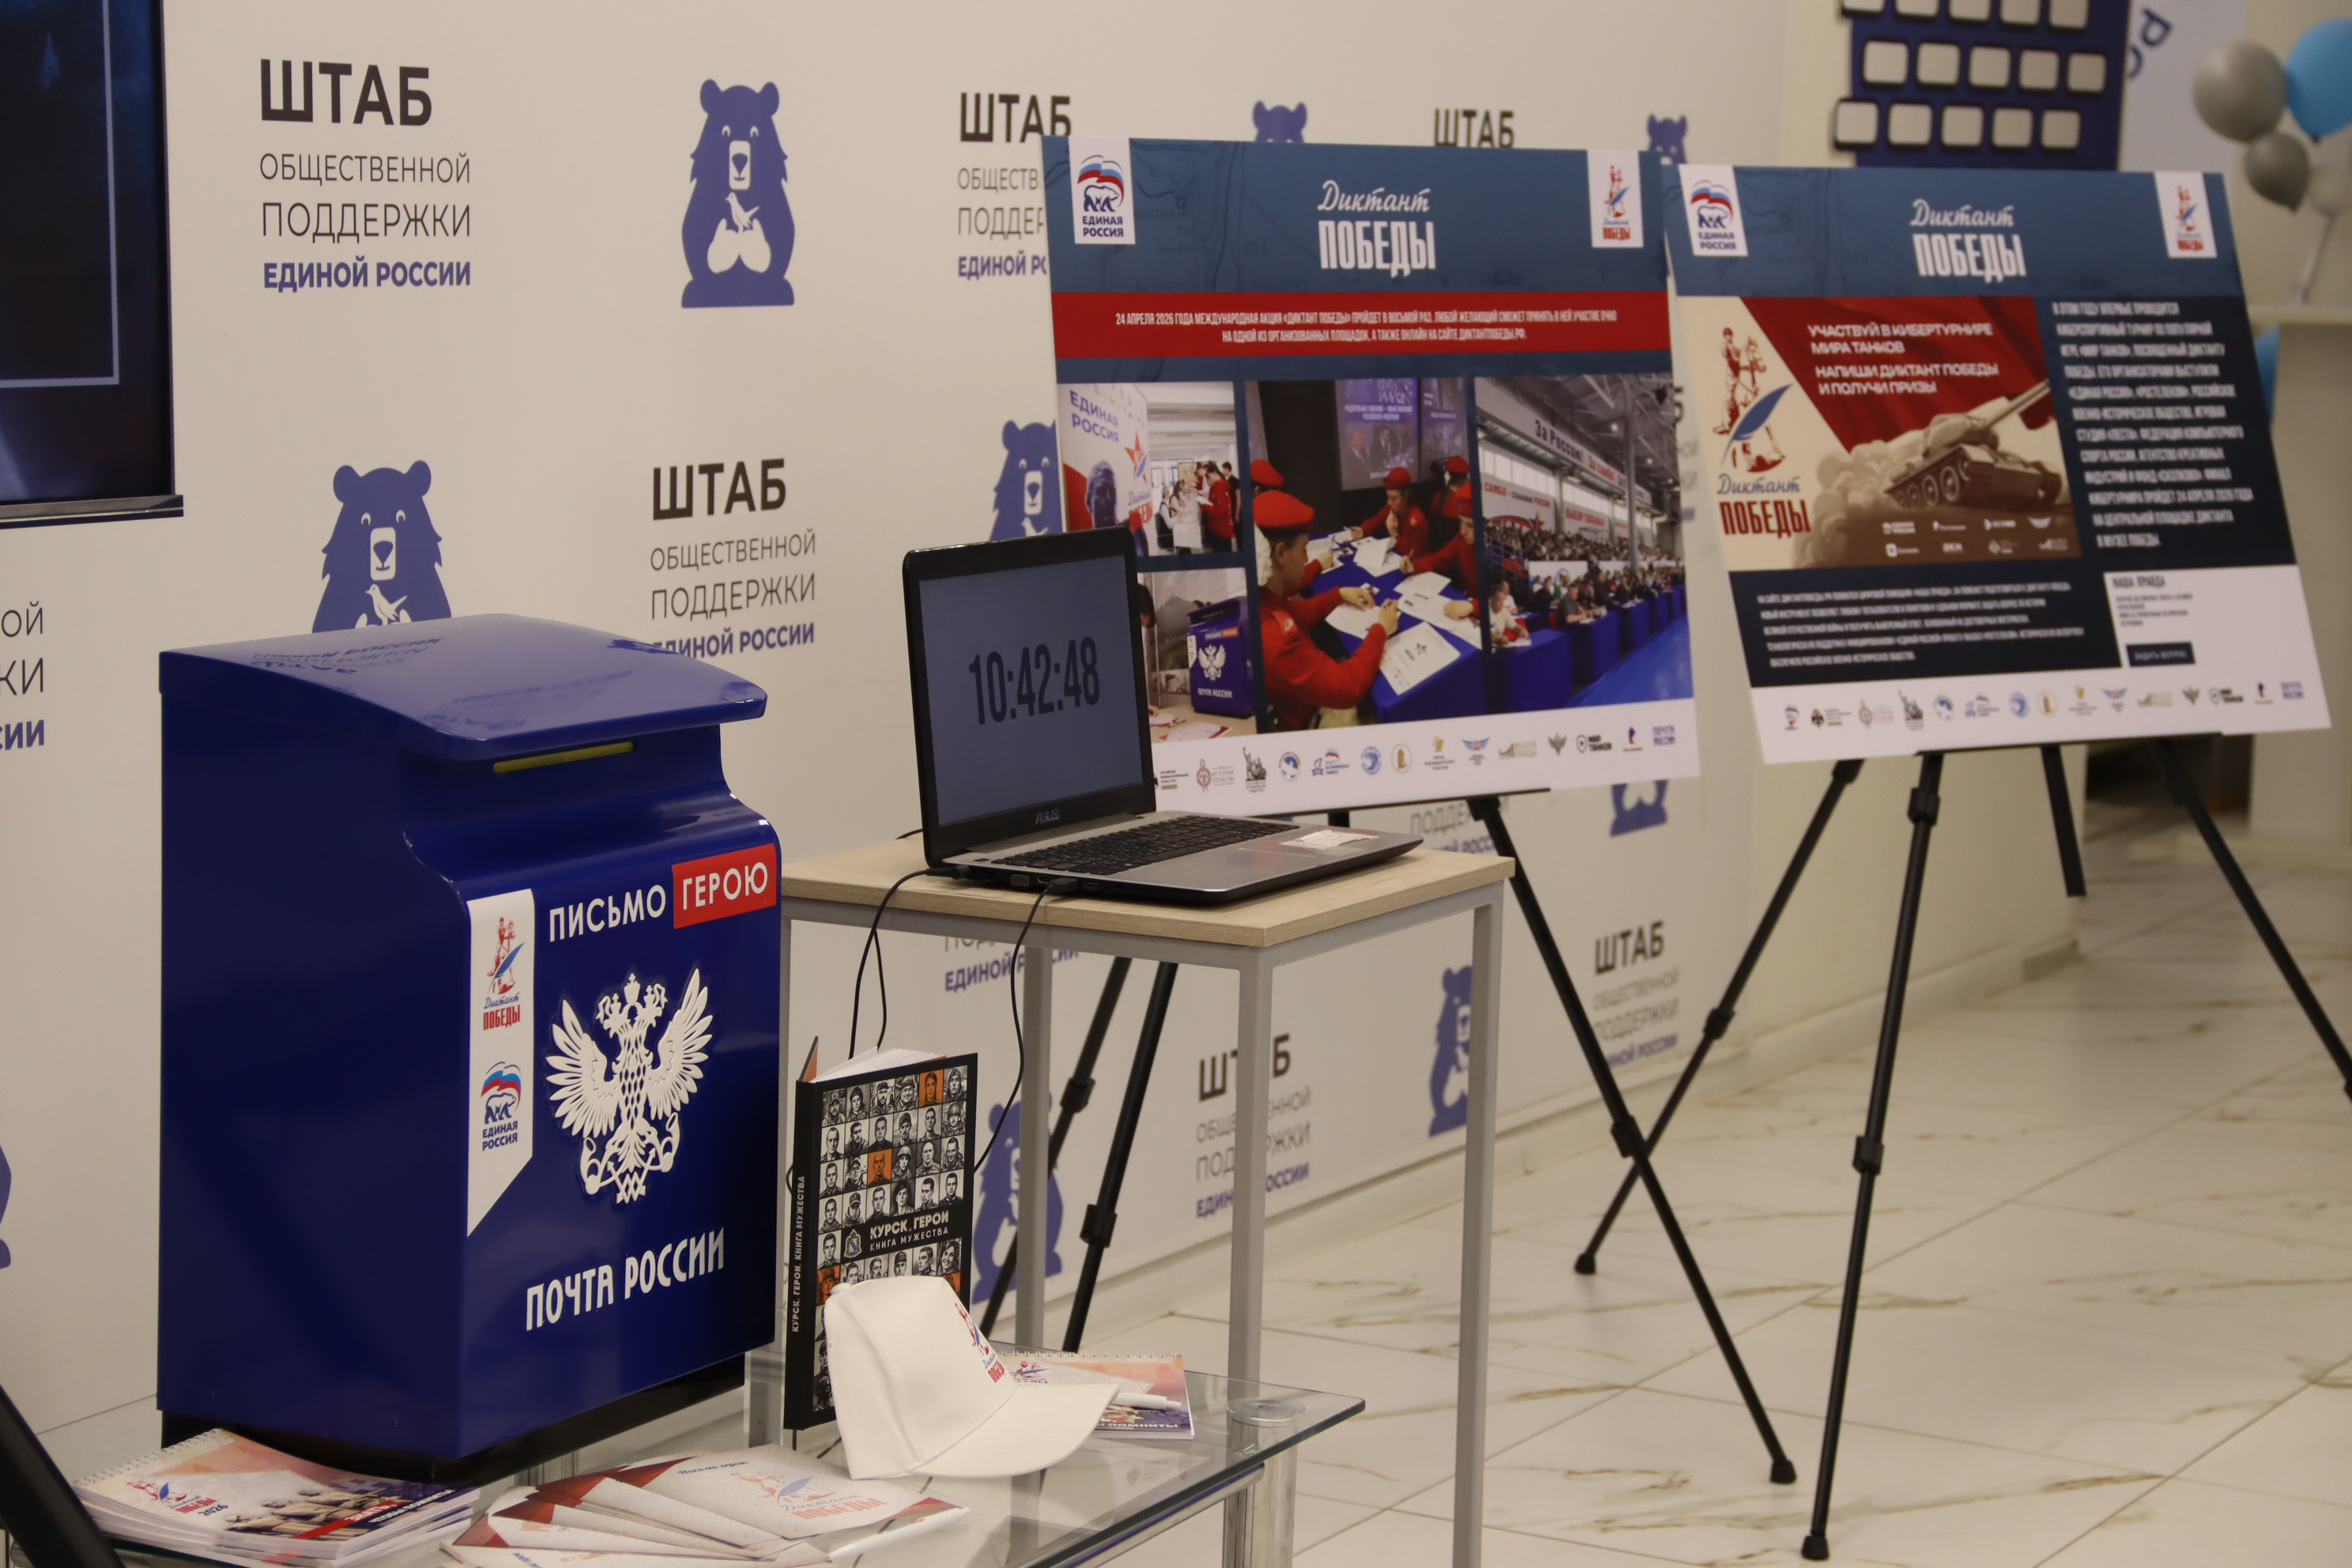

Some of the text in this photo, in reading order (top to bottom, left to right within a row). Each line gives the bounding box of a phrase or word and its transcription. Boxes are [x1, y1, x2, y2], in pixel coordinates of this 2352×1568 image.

[260, 58, 432, 126] ШТАБ
[960, 92, 1072, 142] ШТАБ
[1434, 107, 1515, 149] ШТАБ
[259, 152, 470, 186] ОБЩЕСТВЕННОЙ
[1317, 179, 1431, 213] Диктант
[262, 202, 470, 243] ПОДДЕРЖКИ
[1082, 215, 1124, 226] ЕДИНАЯ
[1909, 198, 2015, 228] Диктант
[1083, 226, 1124, 238] РОССИЯ
[1317, 220, 1437, 278] ПОБЕДЫ
[1912, 233, 2028, 283] ПОБЕДЫ
[264, 255, 471, 292] ЕДИНОЙ РОССИИ
[958, 250, 1026, 281] ЕДИНОЙ
[1115, 312, 1125, 325] 24
[1126, 312, 1155, 326] АПРЕЛЯ
[1155, 312, 1174, 325] 2026
[1174, 313, 1194, 326] ГОДА
[1194, 311, 1259, 326] МЕЖДУНАРОДНАЯ
[1259, 311, 1283, 325] АКЦИЯ
[1807, 321, 1993, 338] УЧАСТВУЙ В КИБЕРТУРНИРЕ
[1222, 330, 1232, 342] НА
[1233, 329, 1257, 343] ОДНОЙ
[1257, 330, 1268, 342] ИЗ
[1268, 330, 1330, 342] ОРГАНИЗОВАННЫХ
[1811, 341, 1905, 355] МИРА ТАНКОВ
[1815, 363, 2000, 379] НАПИШИ ДИКТАНТ ПОБЕДЫ
[1819, 379, 1938, 395] И ПОЛУЧИ ПРИЗЫ
[1070, 390, 1118, 427] ЕДИНАЯ
[1072, 413, 1119, 443] РОССИЯ
[652, 458, 786, 521] ШТАБ
[1717, 473, 1801, 496] Диктант
[1719, 499, 1811, 541] ПОБЕДЫ
[650, 527, 816, 571] ОБЩЕСТВЕННОЙ
[650, 572, 816, 620] ПОДДЕРЖКИ
[740, 623, 815, 654] РОССИИ
[968, 636, 1100, 726] 10:42:48
[1035, 808, 1060, 824] ASUS
[549, 861, 769, 943] ПИСЬМО ГЕРОЮ
[1595, 921, 1664, 976] ШТАБ
[945, 951, 1011, 993] ЕДИНОЙ
[483, 992, 520, 1010] Диктант
[483, 1004, 521, 1031] ПОБЕДЫ
[482, 1121, 518, 1139] ЕДИНАЯ
[482, 1132, 518, 1152] РОССИЯ
[796, 1175, 805, 1230] МУЖЕСТВА
[794, 1231, 804, 1261] КНИГА
[870, 1226, 949, 1251] КНИГА МУЖЕСТВА
[526, 1227, 724, 1332] ПОЧТА РОССИИ
[792, 1298, 801, 1332] КУРСК.
[677, 1461, 748, 1475] Письмо герою
[198, 1503, 229, 1517] 2026
[780, 1494, 863, 1512] Диктант
[792, 1498, 888, 1521] ПОБЕДЫ
